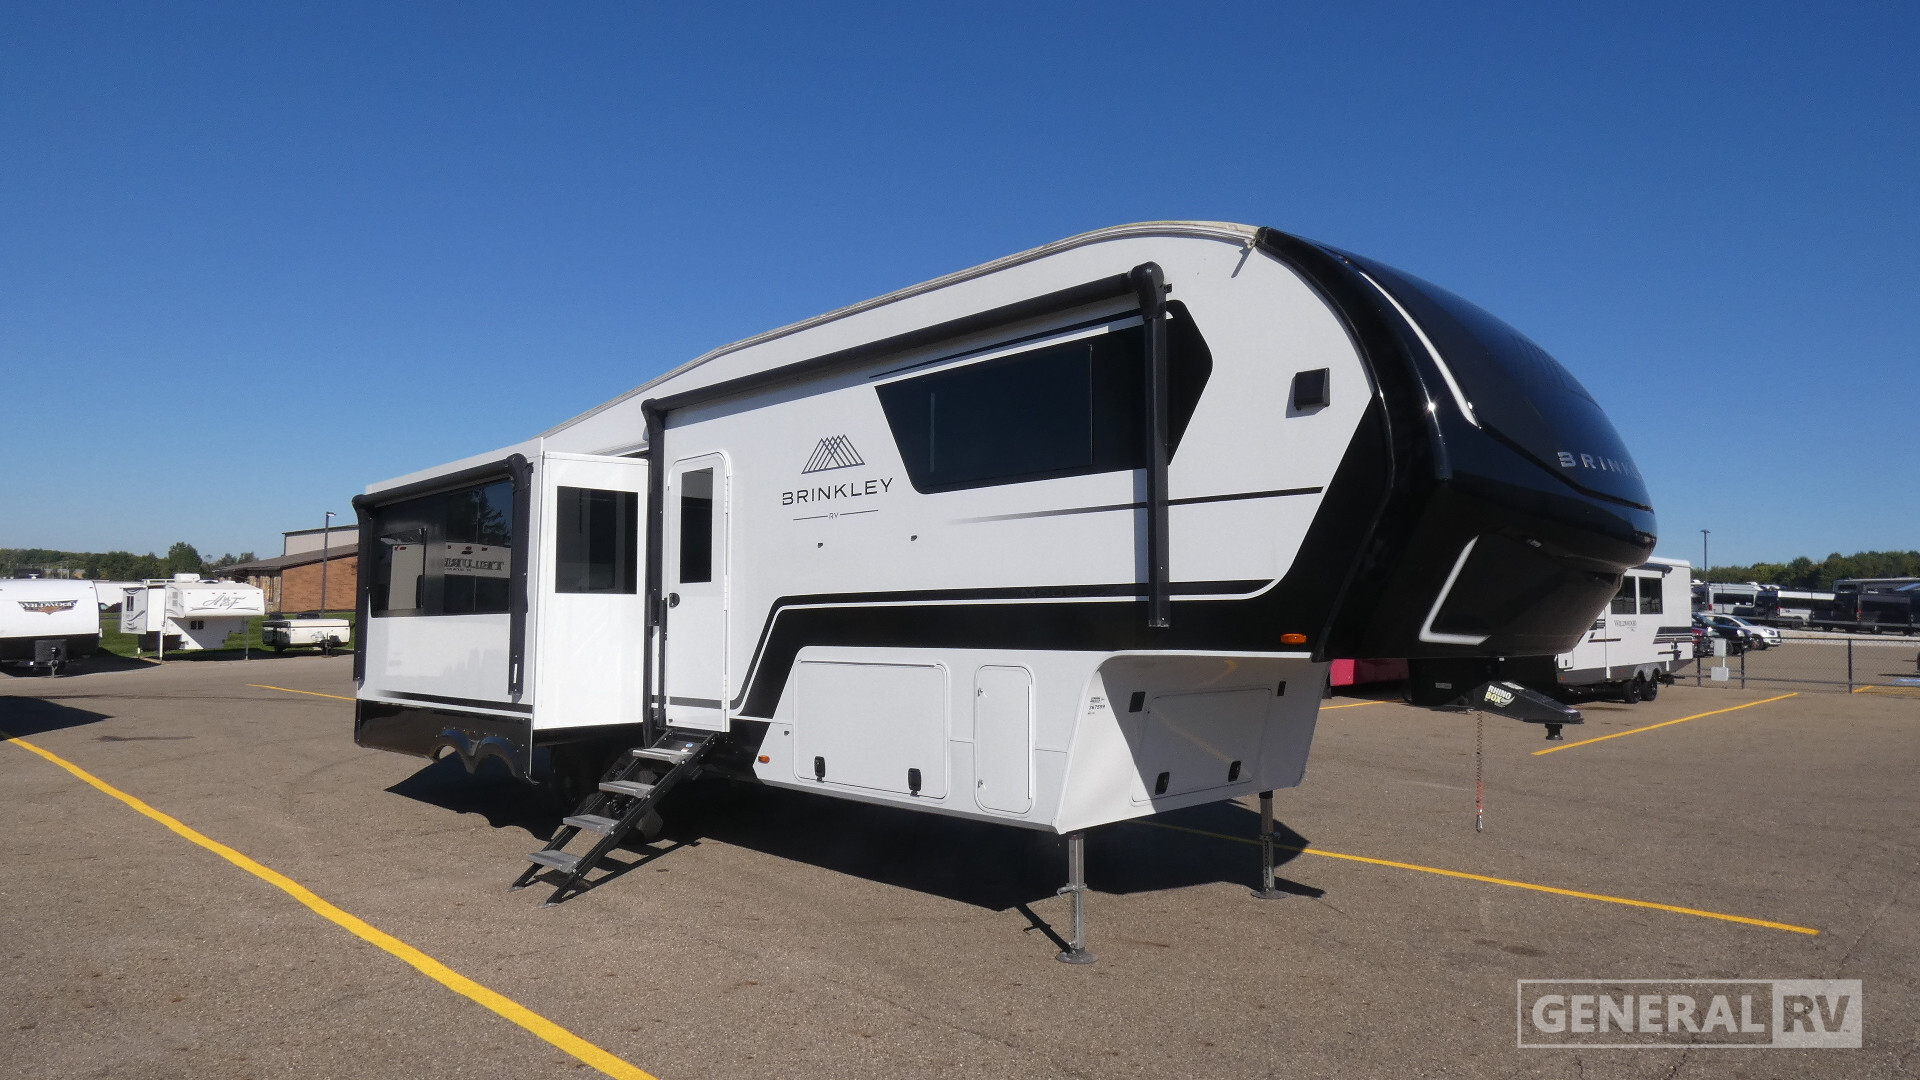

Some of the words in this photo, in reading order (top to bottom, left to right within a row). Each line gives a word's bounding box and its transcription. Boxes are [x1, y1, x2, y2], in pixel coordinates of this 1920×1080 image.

[782, 477, 893, 506] BRINKLEY
[828, 512, 839, 520] RV
[1485, 692, 1502, 703] BOX
[1488, 685, 1511, 699] RHINO
